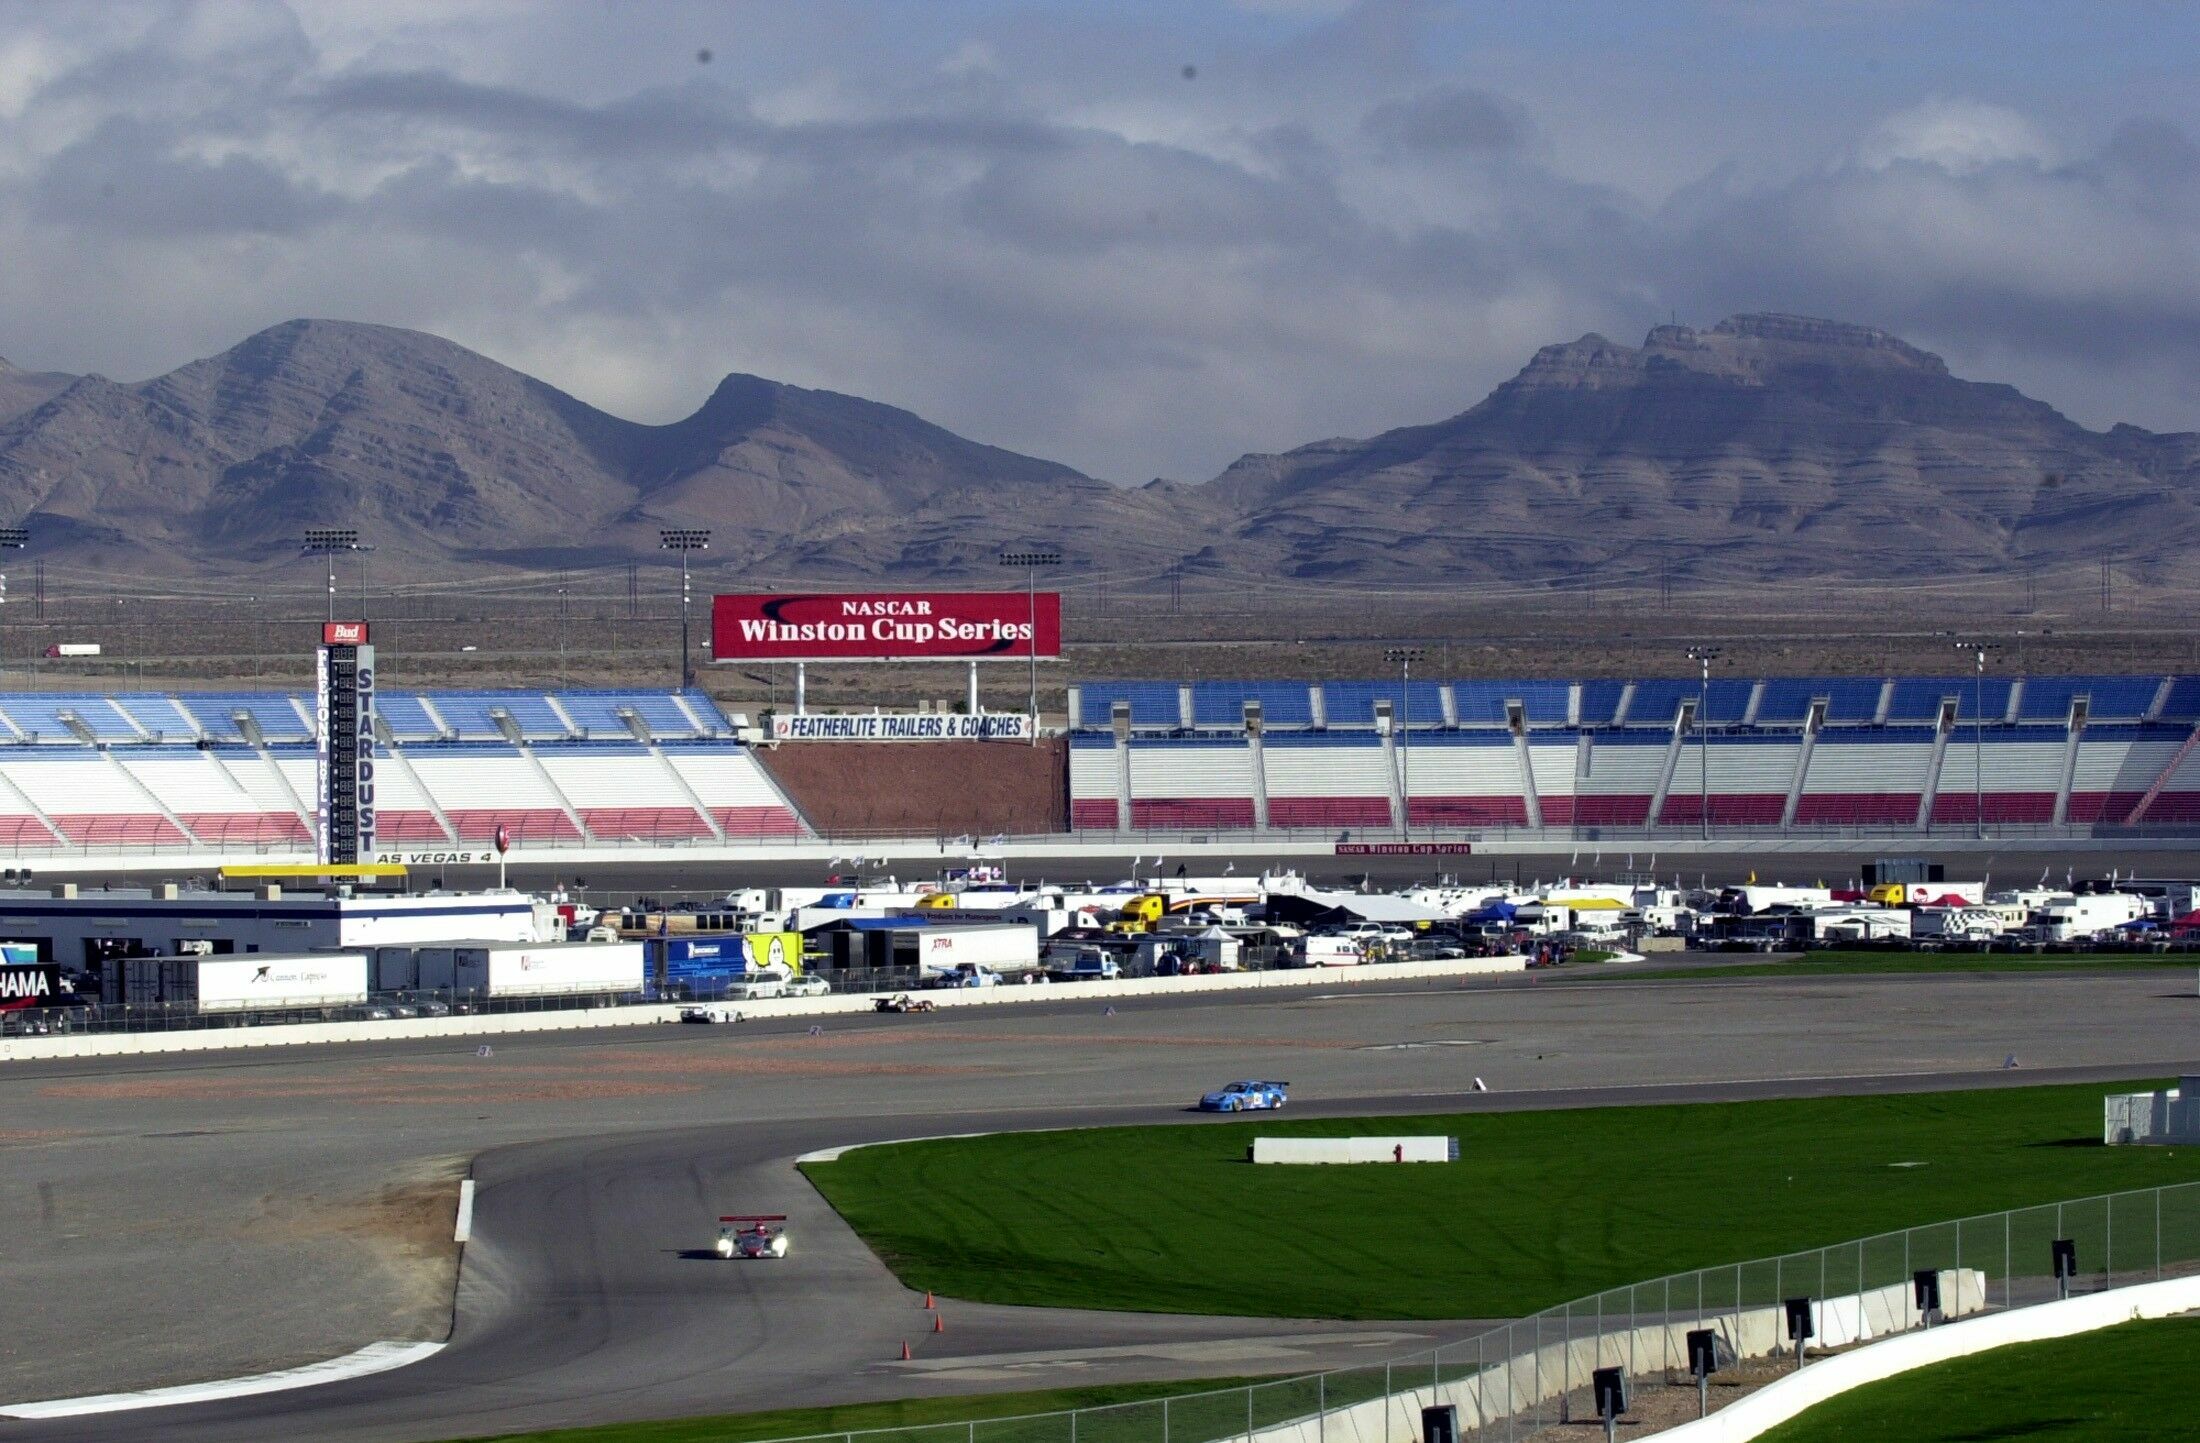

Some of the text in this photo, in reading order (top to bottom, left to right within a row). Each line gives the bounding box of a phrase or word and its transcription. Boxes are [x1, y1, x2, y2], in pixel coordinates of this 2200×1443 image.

[842, 601, 932, 616] NASCAR
[334, 624, 359, 638] Bud
[739, 618, 1033, 643] Winston Cup Series
[317, 649, 329, 753] FREMONT
[791, 716, 1022, 737] FEATHERLITE TRAILERS & COACHES
[358, 668, 375, 852] STARDUST
[376, 854, 402, 863] AS
[410, 853, 471, 862] VEGAS
[1369, 844, 1410, 854] Winston
[1413, 844, 1433, 855] Cup
